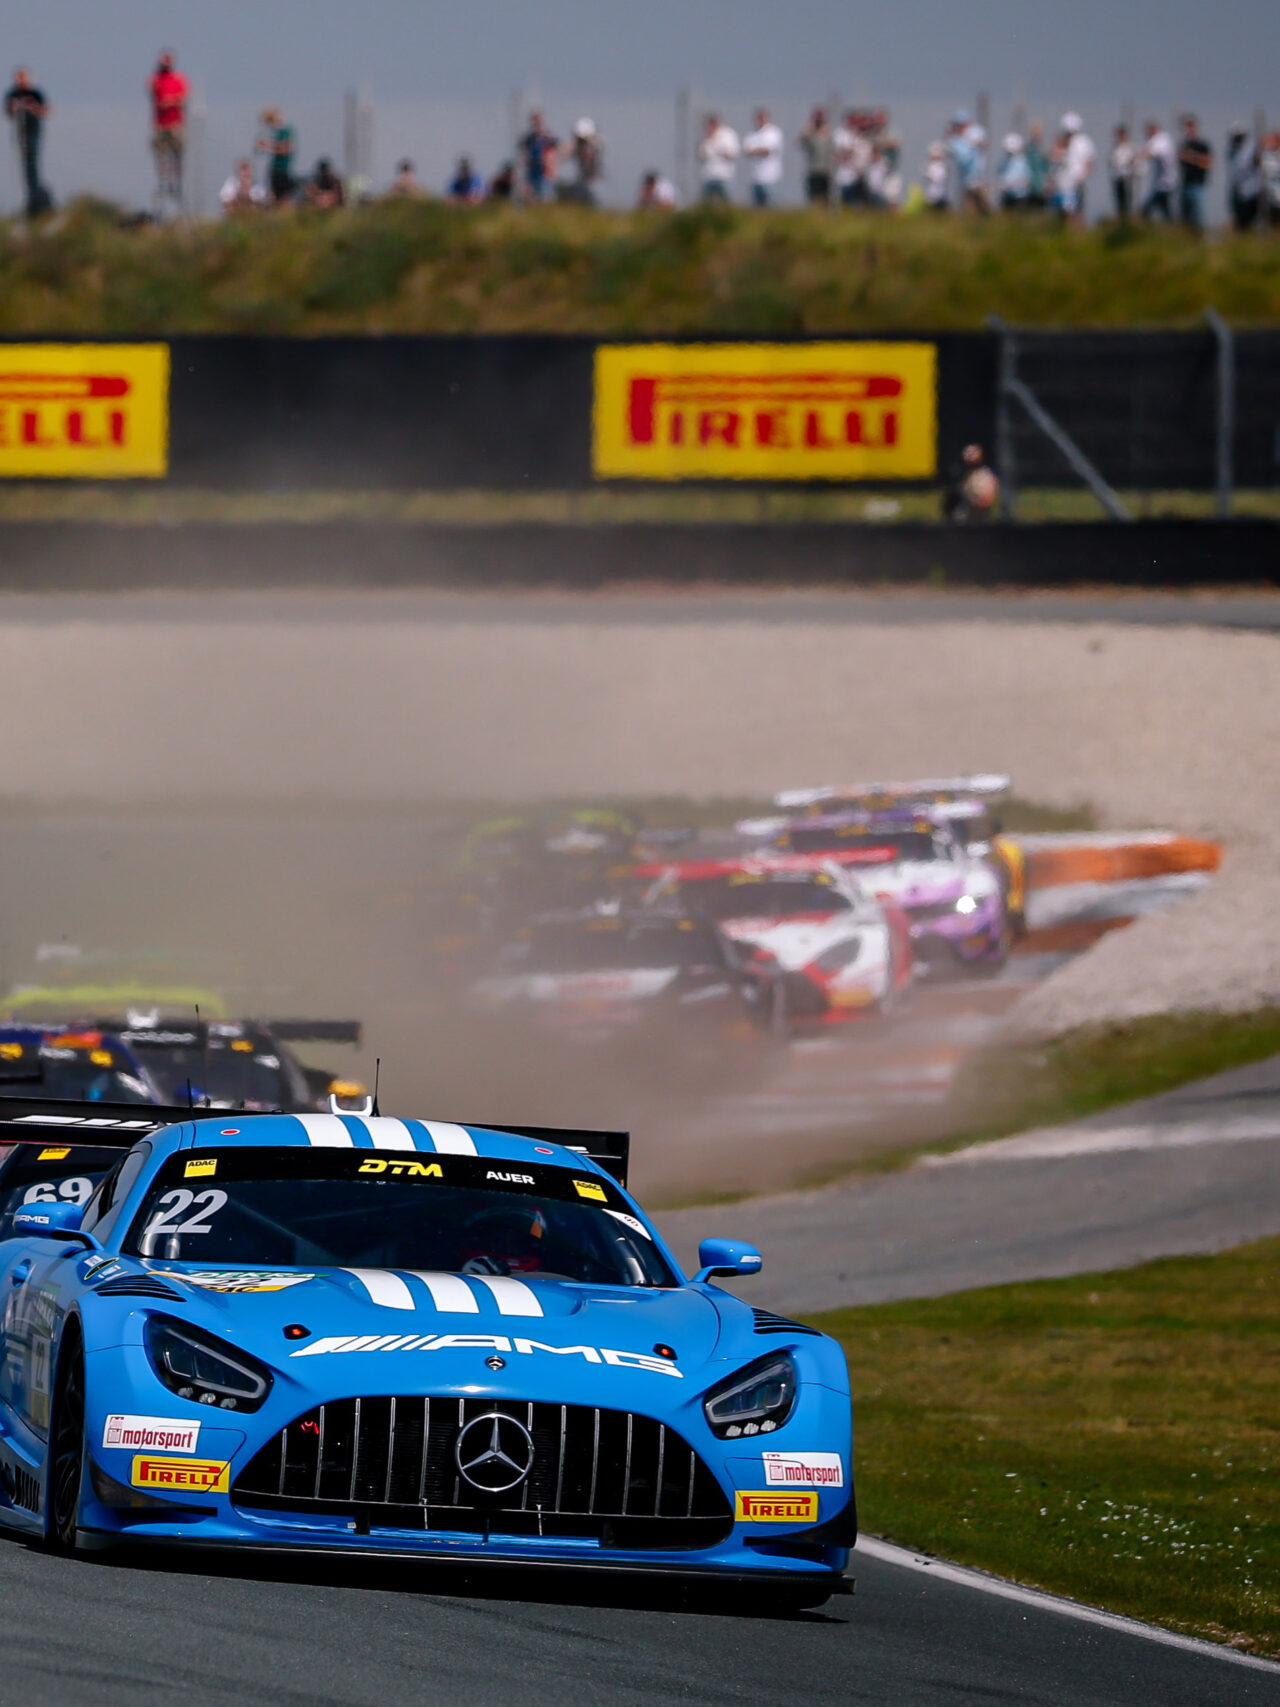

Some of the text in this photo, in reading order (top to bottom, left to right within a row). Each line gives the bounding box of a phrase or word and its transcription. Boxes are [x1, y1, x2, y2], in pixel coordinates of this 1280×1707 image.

[626, 372, 904, 449] PIRELLI
[187, 1160, 216, 1168] ADAC
[357, 1158, 444, 1178] DTM
[486, 1170, 536, 1185] AUER
[23, 1177, 94, 1206] 69
[146, 1188, 229, 1234] 22
[121, 1428, 194, 1449] motorsport
[139, 1460, 222, 1486] PIRELLI
[784, 1465, 840, 1485] motorsport
[742, 1495, 812, 1517] PIRELLI
